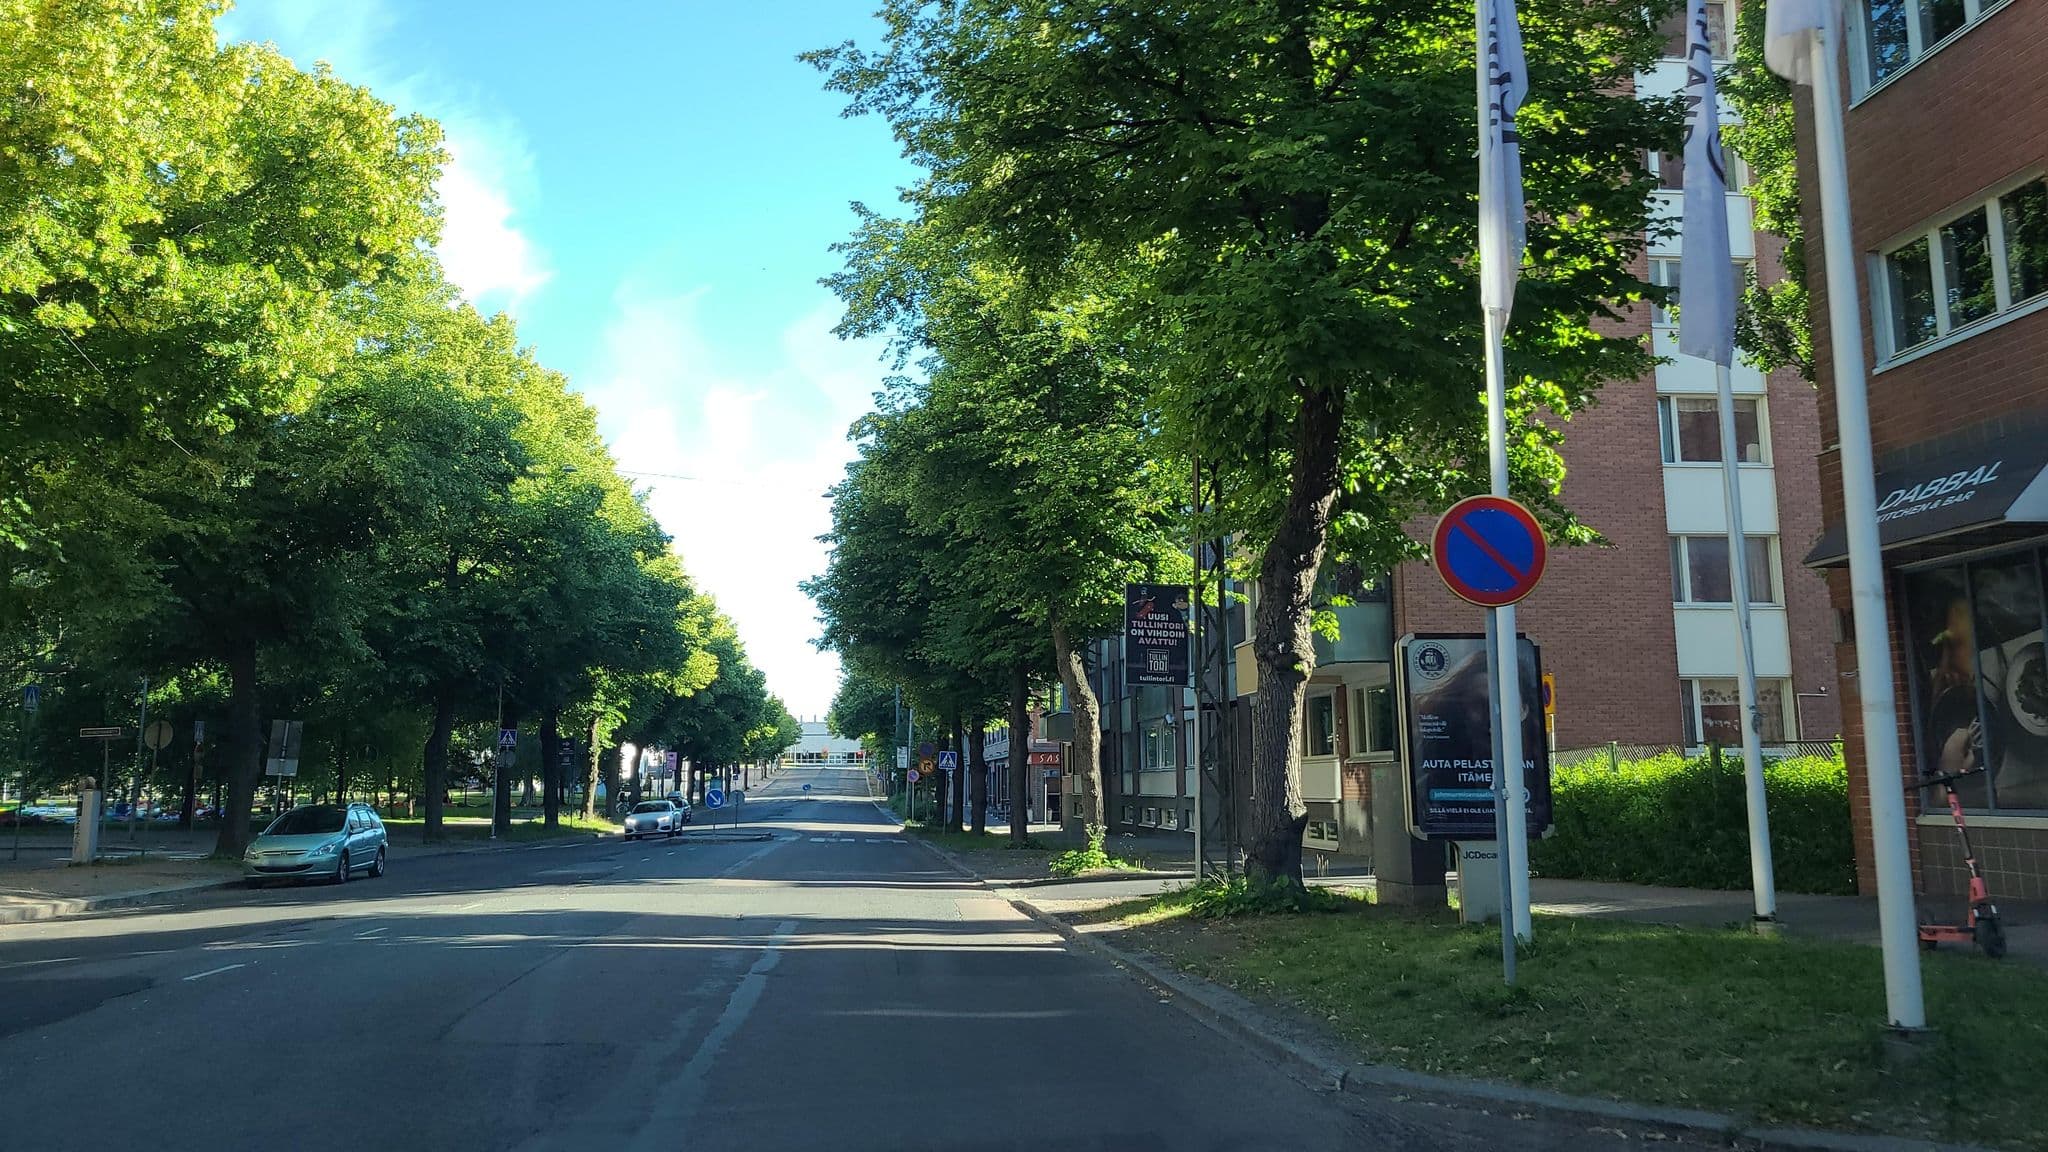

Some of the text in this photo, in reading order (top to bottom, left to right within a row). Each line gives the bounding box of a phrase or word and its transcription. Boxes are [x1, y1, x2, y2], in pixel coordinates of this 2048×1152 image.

[1876, 460, 2002, 511] DABBAL
[1941, 490, 1976, 506] BAR
[1147, 613, 1169, 621] UUSI
[1132, 620, 1184, 630] TULLINTORI
[1130, 628, 1185, 638] ON VIHDOIN
[1138, 637, 1177, 646] AVATTU!
[1149, 653, 1168, 661] TULLIN
[1149, 661, 1168, 671] TORI
[1422, 759, 1452, 769] AUTA
[1458, 770, 1495, 782] ITÄME
[1463, 851, 1498, 859] JCDeca
